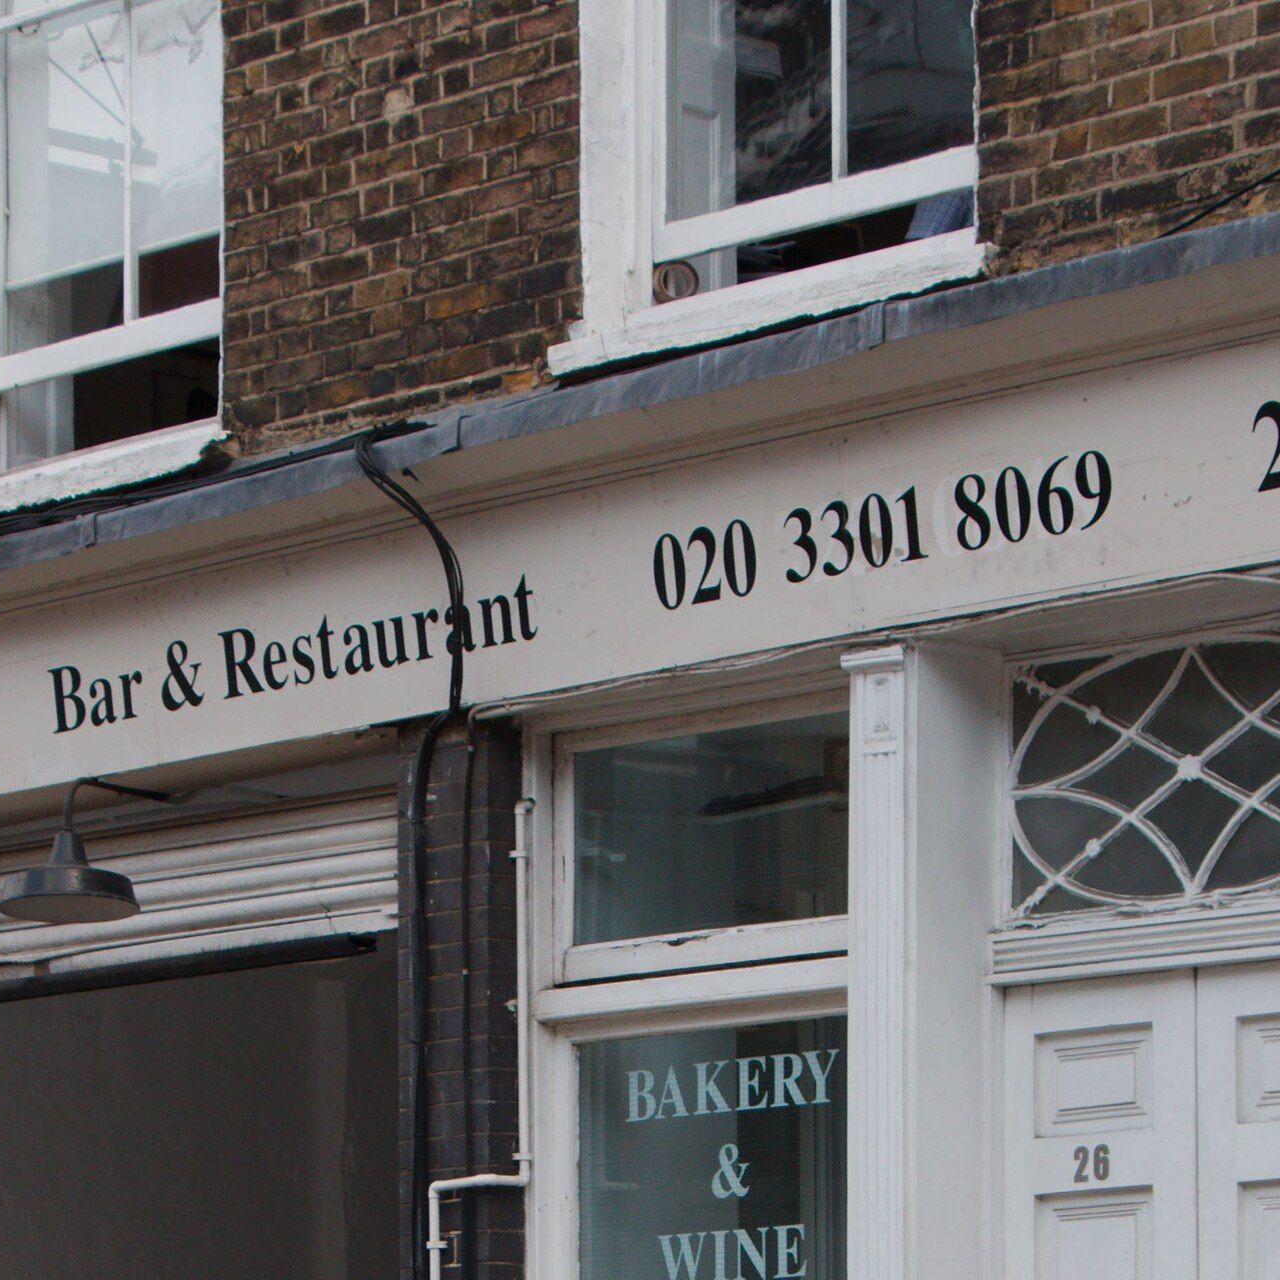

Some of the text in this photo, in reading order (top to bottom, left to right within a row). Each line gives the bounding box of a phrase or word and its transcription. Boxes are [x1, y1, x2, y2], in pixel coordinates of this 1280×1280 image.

[653, 450, 1113, 610] 020 3301 8069
[52, 573, 538, 734] Bar & Restaurant
[625, 1049, 841, 1123] BAKERY
[711, 1143, 750, 1199] &
[1073, 1143, 1111, 1183] 26
